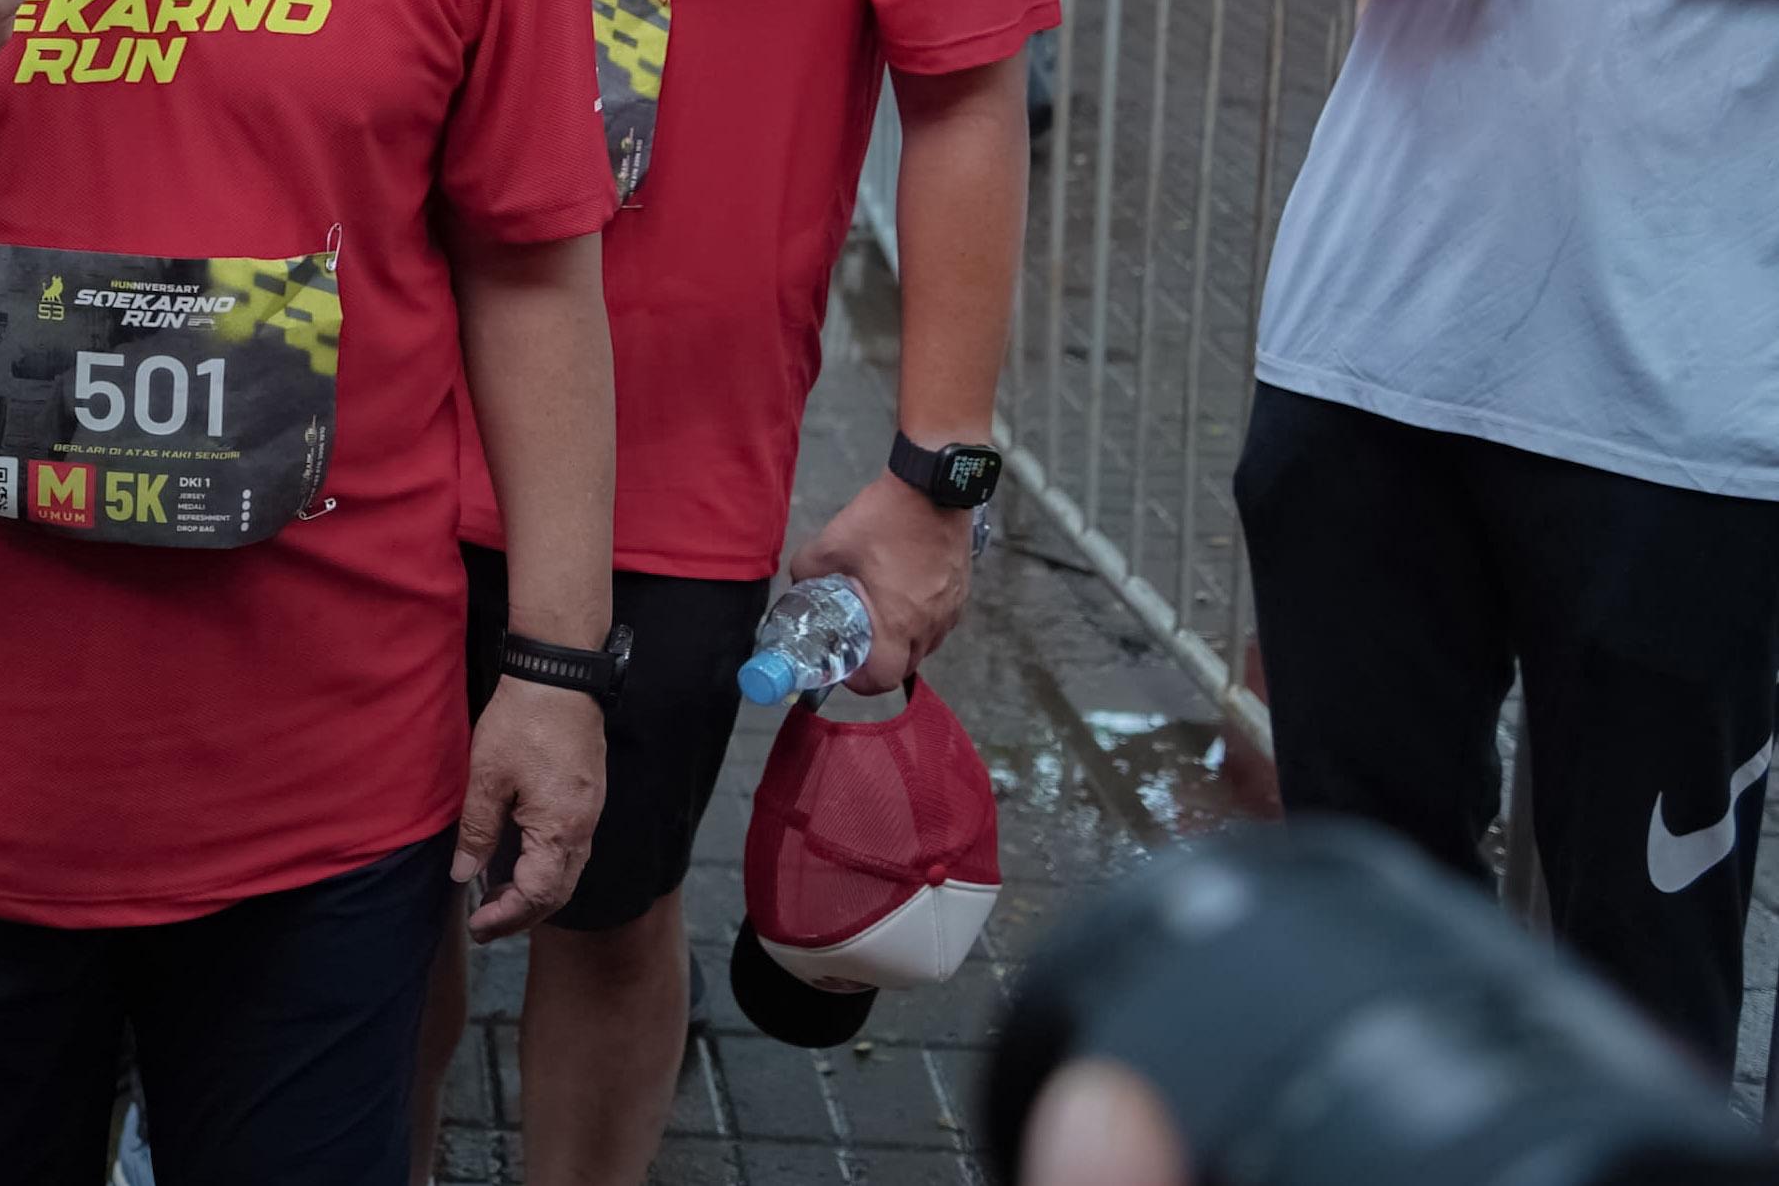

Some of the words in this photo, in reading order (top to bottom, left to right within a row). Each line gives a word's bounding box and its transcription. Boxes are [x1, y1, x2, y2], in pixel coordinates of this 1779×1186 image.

[14, 37, 188, 85] RUN
[110, 279, 200, 294] RUNNIVERSARY
[73, 289, 236, 314] SOEKARNO
[37, 303, 65, 321] 53
[120, 310, 186, 329] RUN
[73, 350, 226, 438] 501
[53, 443, 106, 455] BERLARI
[109, 447, 122, 456] DI
[125, 448, 159, 458] ATAS
[161, 449, 192, 459] KAKI
[195, 450, 241, 461] SENDIRI
[179, 476, 202, 488] DKI
[205, 477, 212, 488] 1
[37, 464, 87, 510] M
[105, 471, 169, 524] 5K
[178, 492, 206, 501] JERSEY
[177, 502, 206, 511] MEDALI
[38, 509, 86, 523] UMUM
[176, 524, 199, 533] DROP
